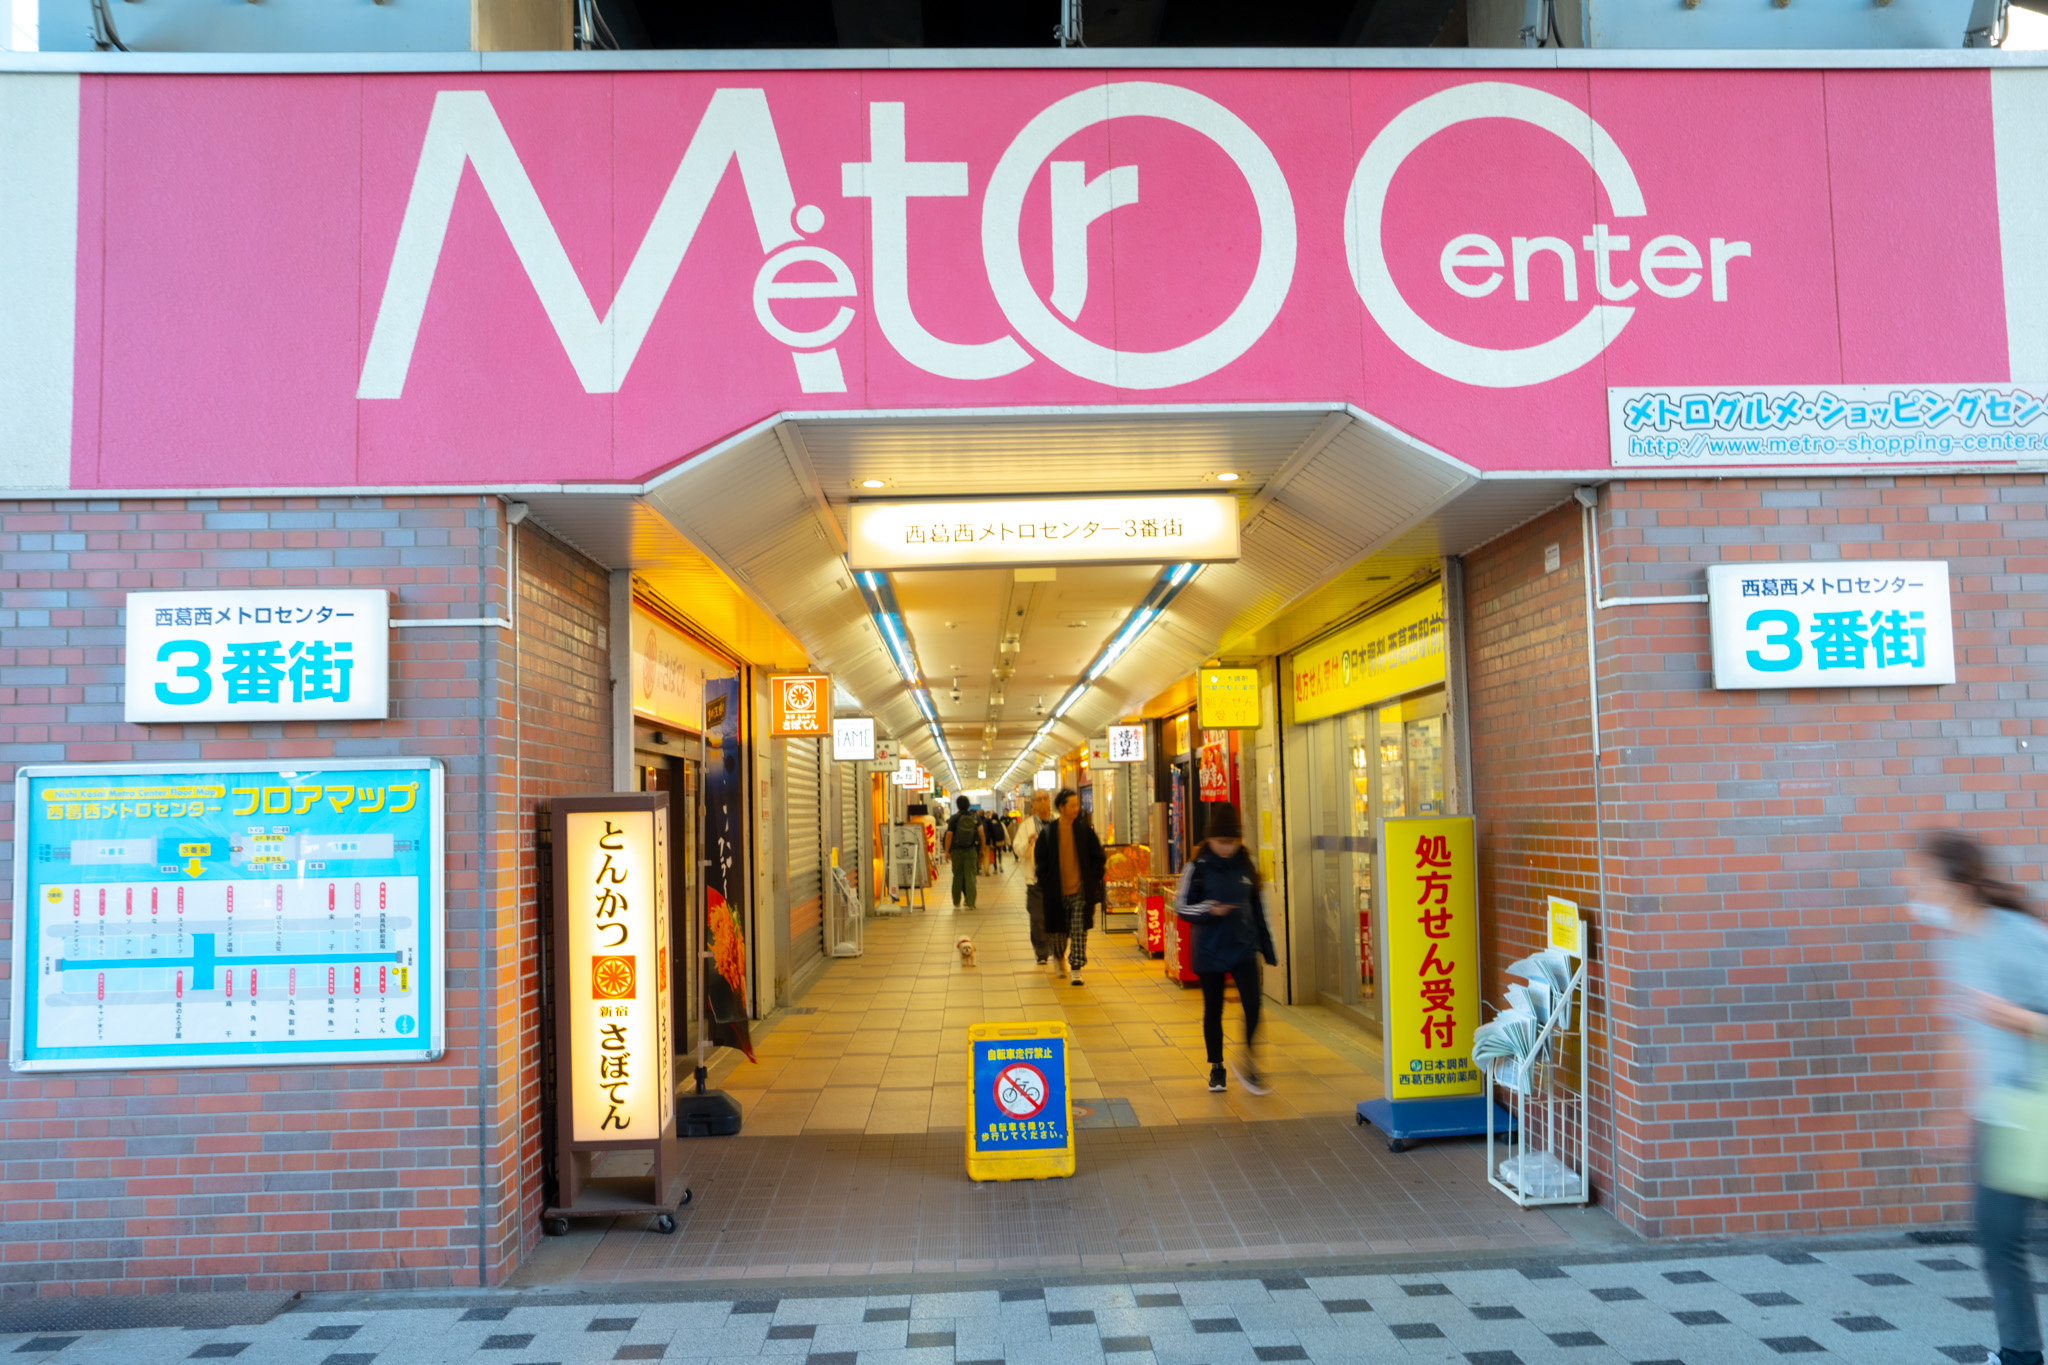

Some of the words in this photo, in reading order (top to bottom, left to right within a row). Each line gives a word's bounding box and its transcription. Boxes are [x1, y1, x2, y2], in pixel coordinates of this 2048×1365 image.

[1344, 81, 1751, 388] Center
[1627, 392, 2048, 430] メトログルメ・ショッピングセン
[905, 517, 1184, 544] 西葛西メトロセンター3番街
[1741, 577, 1924, 597] 西葛西メトロセンター
[154, 606, 355, 627] 西葛西メトロセンター
[1745, 609, 1927, 672] 3番街
[1296, 655, 1339, 703] 処方せん受付
[1351, 636, 1386, 682] 日本調剤
[1388, 611, 1445, 669] 西葛西駅前
[154, 639, 354, 705] 3番街
[782, 720, 819, 731] さぼてん
[837, 729, 871, 748] FAME
[54, 790, 78, 799] Nishi
[109, 789, 135, 798] Metro
[138, 788, 167, 798] Center
[170, 788, 192, 797] Floor
[195, 787, 216, 798] Map
[232, 782, 420, 816] フロアマップ
[47, 802, 222, 820] 西葛西メトロセンター
[595, 820, 628, 947] とんかつ
[1415, 835, 1457, 1049] 処方せん受付
[599, 1005, 628, 1018] 新宿
[987, 1047, 1053, 1061] 自転車走行禁止
[1423, 1058, 1468, 1072] 日本調剤
[600, 1023, 631, 1131] さぼてん
[1399, 1072, 1478, 1086] 西葛西駅前薬局
[981, 1131, 1064, 1142] 歩行してください。
[989, 1121, 1055, 1133] 自転車を降りて
